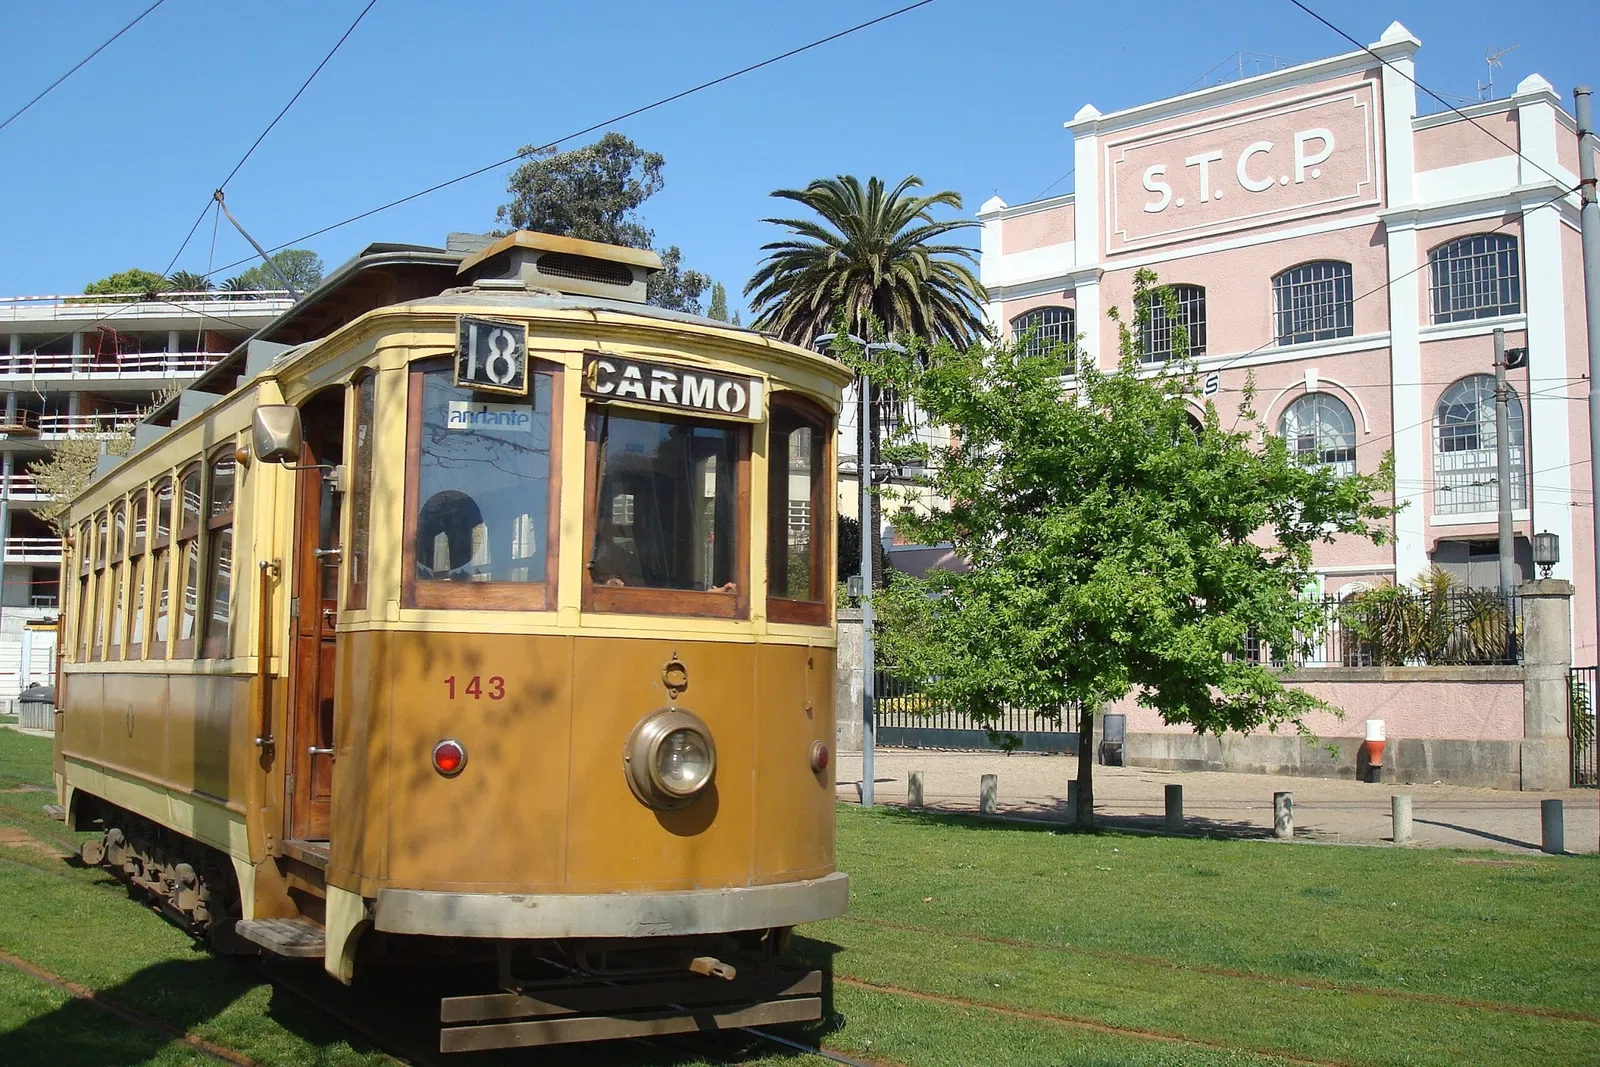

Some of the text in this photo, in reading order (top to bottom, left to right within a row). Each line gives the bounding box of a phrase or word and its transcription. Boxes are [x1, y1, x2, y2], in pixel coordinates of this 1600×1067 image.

[467, 325, 516, 384] 18
[588, 360, 746, 412] CARMO
[450, 405, 529, 425] andante
[444, 676, 505, 700] 143
